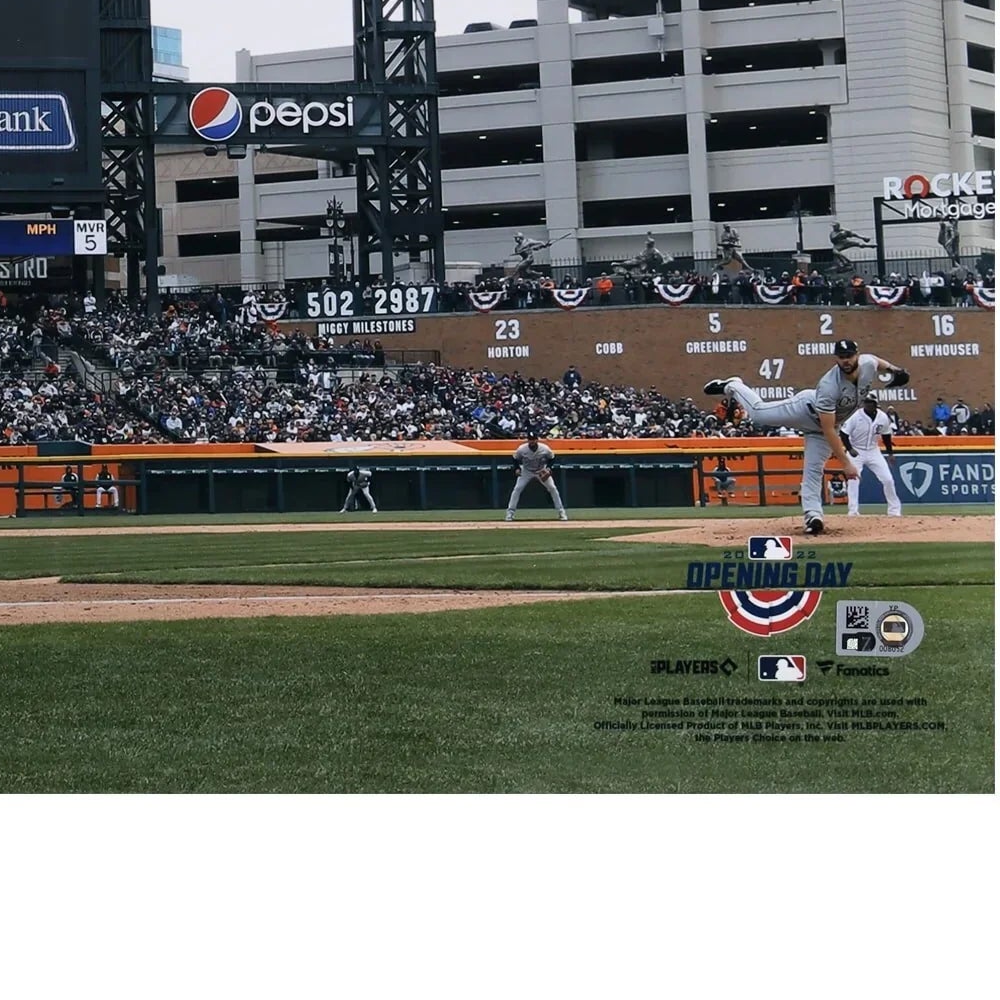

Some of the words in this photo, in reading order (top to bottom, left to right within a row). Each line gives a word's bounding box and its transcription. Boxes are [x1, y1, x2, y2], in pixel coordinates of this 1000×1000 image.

[249, 96, 354, 133] pepsi
[883, 170, 995, 200] ROCKE
[904, 201, 995, 219] Mortgage
[27, 224, 56, 235] MPH
[76, 222, 105, 234] MVR
[307, 291, 353, 317] 502
[375, 287, 434, 314] 2987
[318, 322, 349, 335] MIGGY
[353, 320, 414, 334] MILESTONES
[495, 319, 520, 340] 23
[708, 312, 722, 334] 5
[819, 313, 833, 335] 2
[931, 314, 955, 336] 16
[488, 346, 530, 359] HORTON
[595, 342, 624, 355] COBB
[686, 340, 747, 354] GREENBERG
[910, 343, 979, 358] NEWHOUSER
[759, 358, 784, 380] 47
